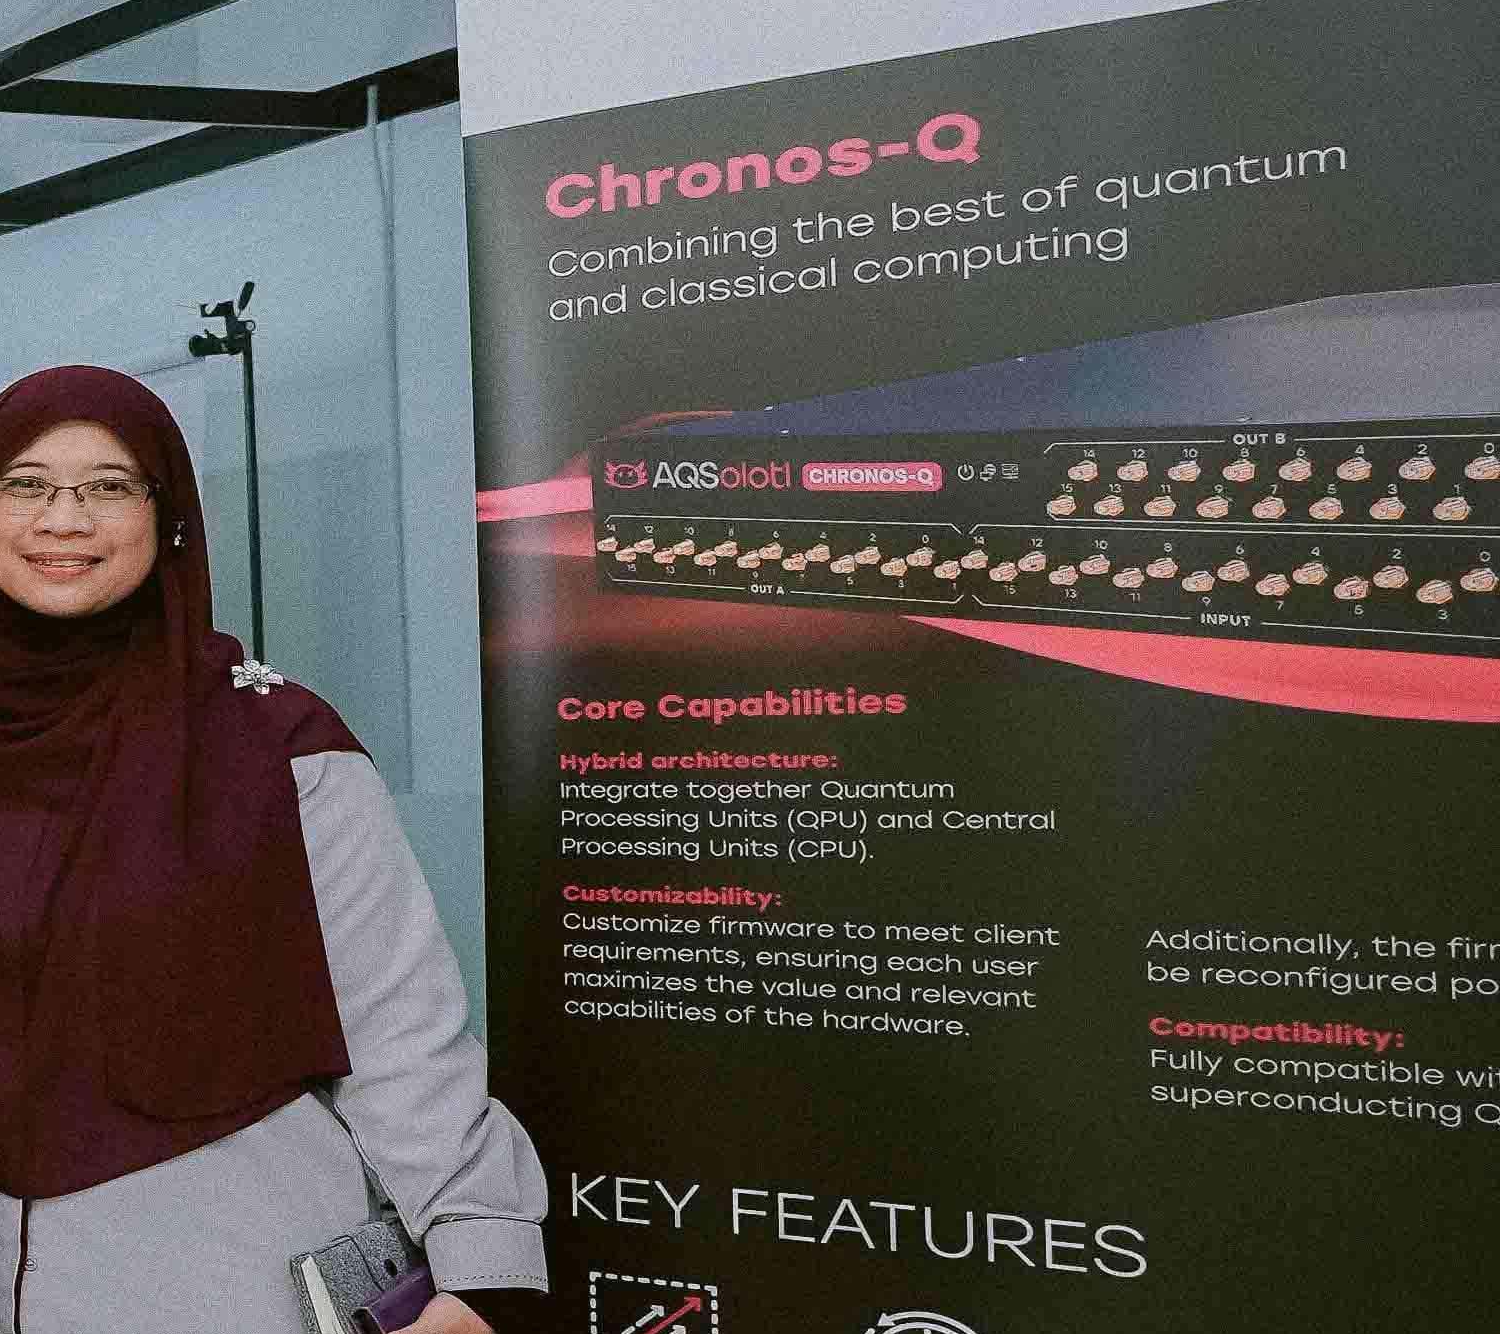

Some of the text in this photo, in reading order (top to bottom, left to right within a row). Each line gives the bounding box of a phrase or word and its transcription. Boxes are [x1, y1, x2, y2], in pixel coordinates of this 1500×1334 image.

[545, 113, 981, 219] Chronos-Q
[548, 146, 1346, 280] Combining the best of quantum
[548, 224, 1130, 322] and classical computing
[1083, 449, 1095, 458] 14
[1132, 449, 1145, 458] 12
[1184, 448, 1198, 458] 10
[1296, 447, 1305, 457] 6
[1356, 444, 1364, 455] 4
[1418, 444, 1427, 454] 2
[1484, 443, 1494, 453] 0
[1233, 434, 1286, 445] OUT B
[653, 460, 934, 491] AQSolotl CHRONOS-Q
[1061, 484, 1073, 492] 15
[1109, 484, 1122, 492] 13
[1161, 484, 1171, 492] 11
[1215, 484, 1222, 493] 9
[1271, 485, 1277, 494] 7
[1388, 484, 1397, 494] 3
[974, 536, 985, 545] 14
[1031, 539, 1043, 548] 12
[1095, 540, 1108, 550] 10
[1236, 545, 1244, 555] 6
[1311, 547, 1320, 556] 4
[1392, 549, 1402, 559] 2
[1480, 551, 1491, 562] 0
[751, 585, 784, 595] OUT A
[1065, 589, 1077, 599] 13
[1131, 593, 1141, 602] 11
[1202, 597, 1212, 606] 9
[1277, 601, 1283, 610] 7
[1437, 609, 1448, 619] 3
[1201, 611, 1251, 627] INPUT
[557, 687, 908, 725] Core Capabilities
[559, 750, 838, 775] Hybrid architecture:
[560, 779, 954, 803] Integrate together Quantum
[562, 808, 1054, 834] Processing Units (QPU) and Central
[562, 837, 873, 864] Processing Units (CPU).
[562, 883, 782, 913] Customizability:
[563, 913, 1060, 946] Customize firmware to meet client
[1145, 928, 1358, 960] Additionally,
[1372, 935, 1436, 957] the
[564, 944, 1039, 976] requirements, ensuring each user
[564, 970, 1036, 1010] maximizes the value and relevant
[1148, 961, 1499, 999] be reconfigured po
[565, 999, 970, 1036] capabilities of the hardware.
[1148, 1017, 1404, 1053] Compatibility:
[1151, 1049, 1223, 1076] Fully
[1234, 1058, 1444, 1085] compatible
[1151, 1086, 1461, 1128] superconducting
[572, 1172, 1148, 1277] KEY FEATURES
